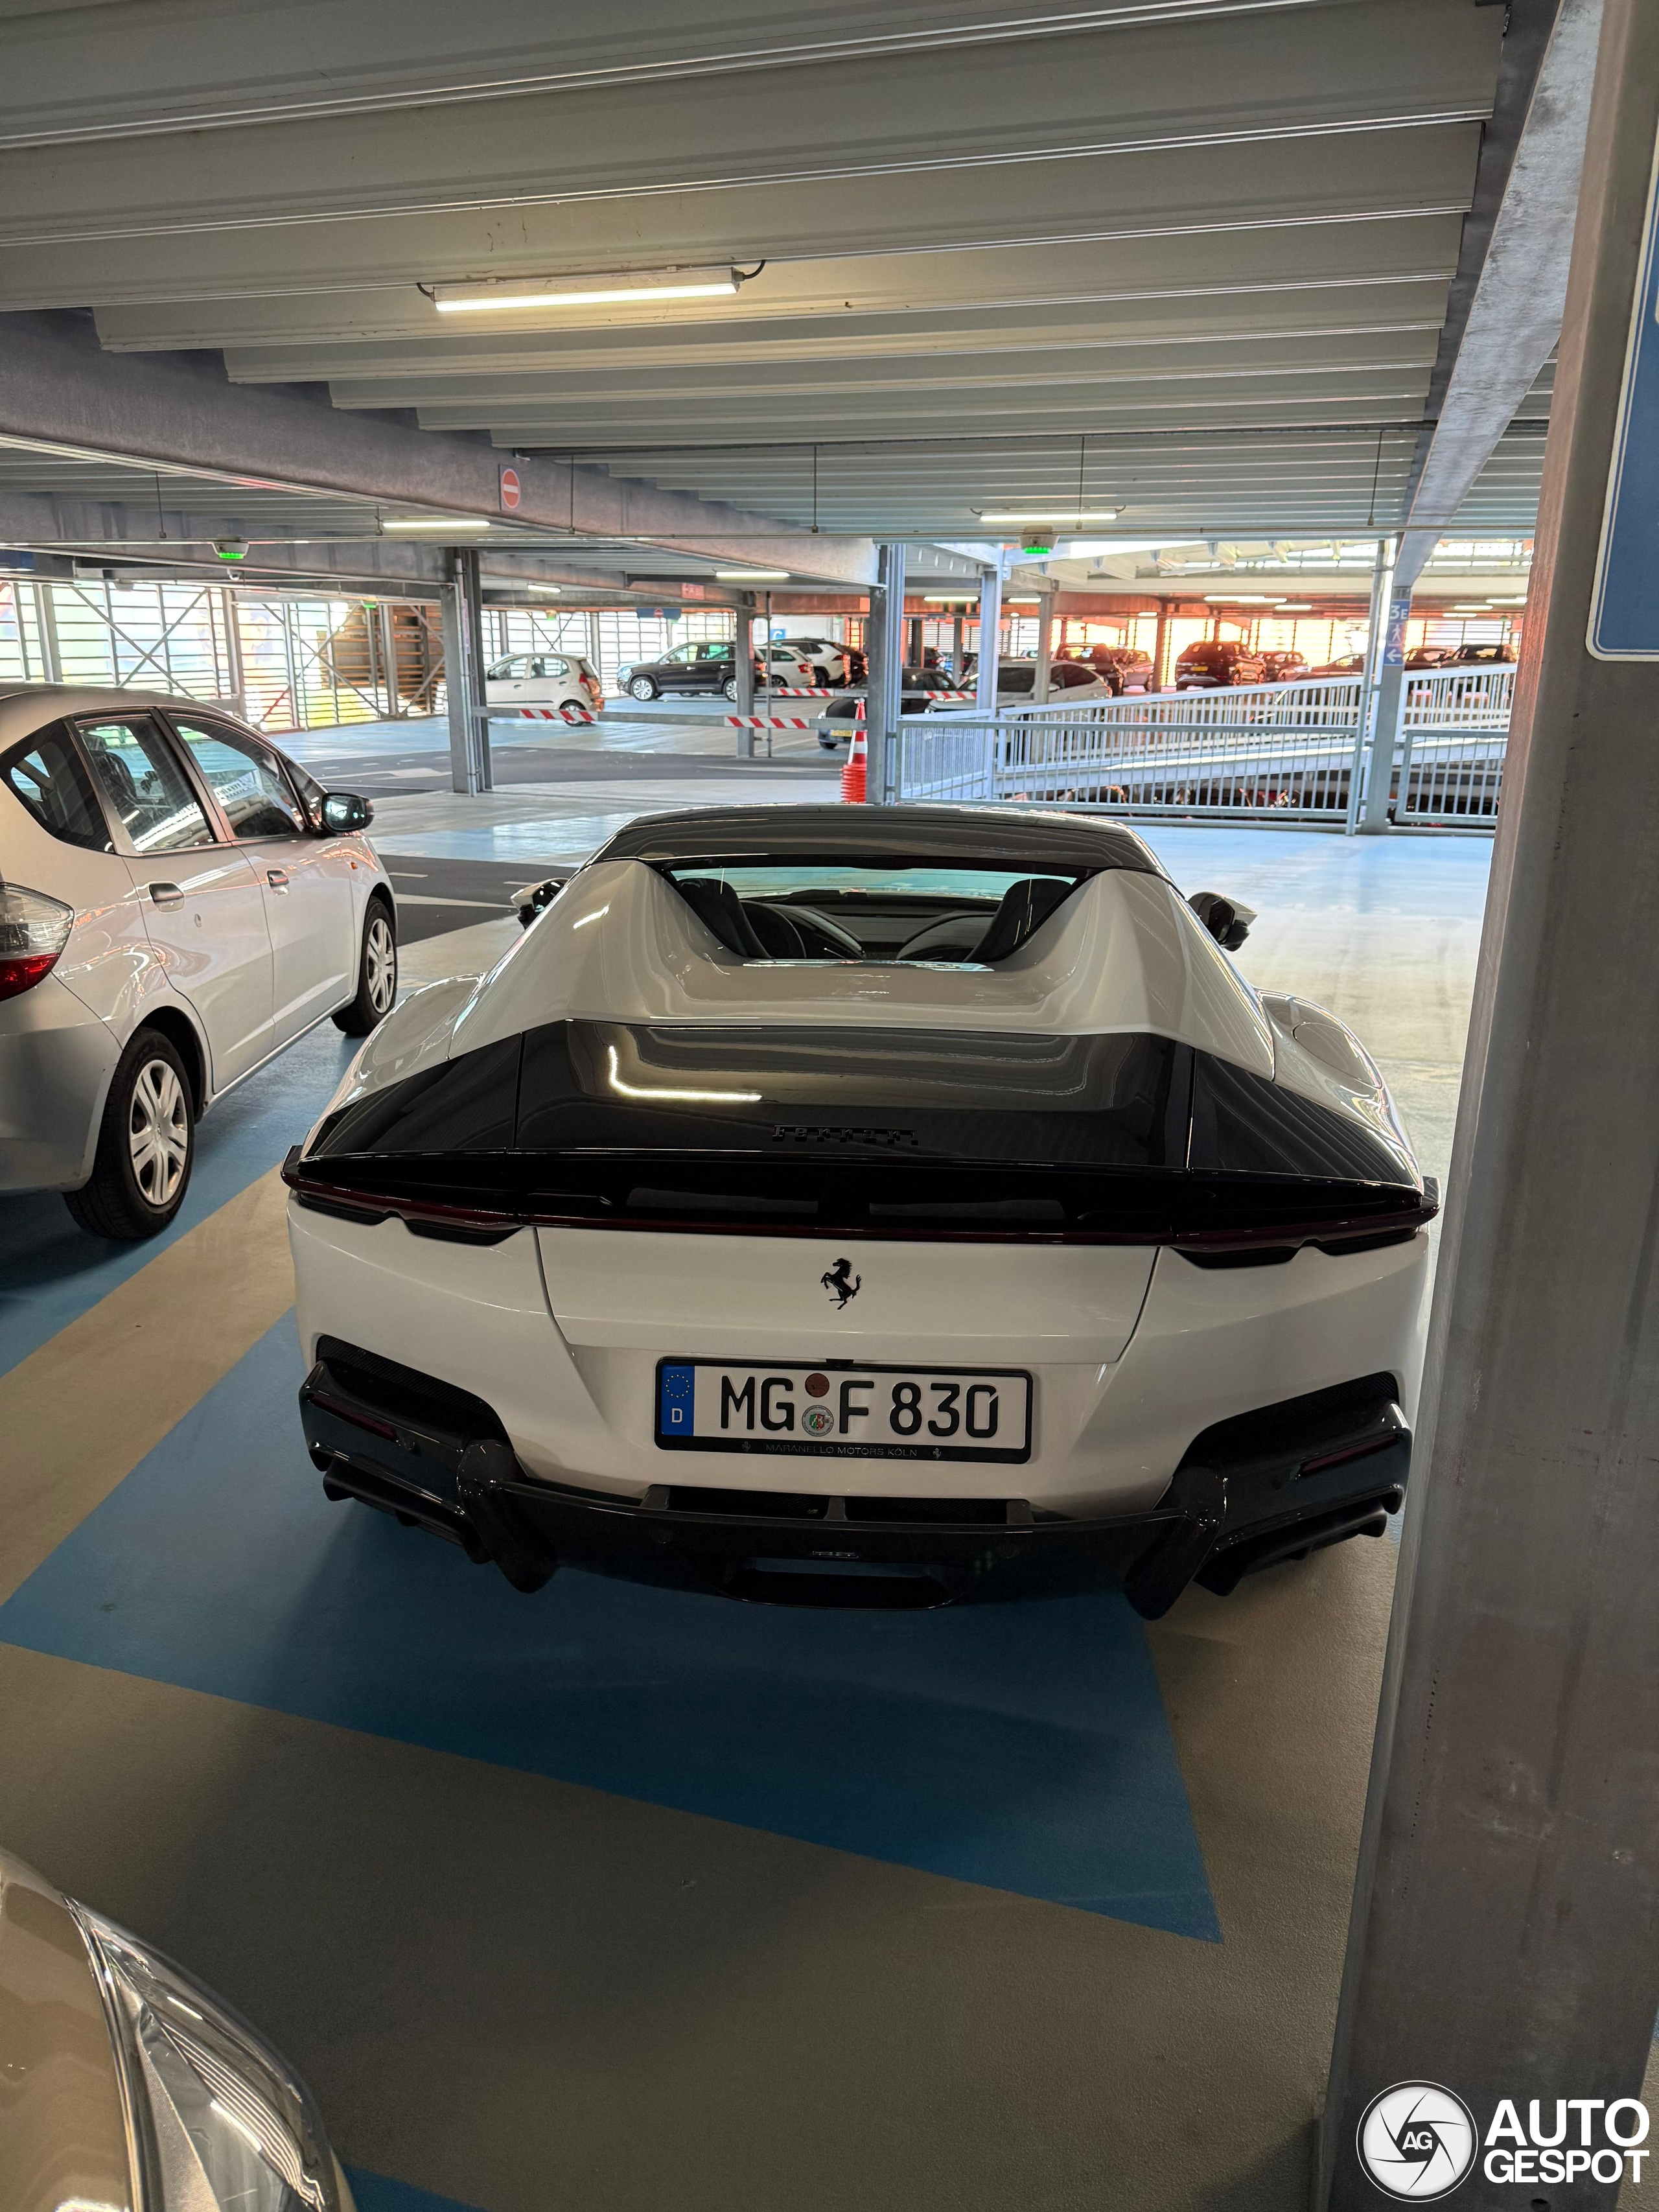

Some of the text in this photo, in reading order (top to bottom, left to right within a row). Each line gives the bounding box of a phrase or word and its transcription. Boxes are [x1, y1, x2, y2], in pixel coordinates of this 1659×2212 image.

[772, 1125, 918, 1144] Ferrari
[671, 1408, 683, 1423] D
[721, 1375, 998, 1439] MG F 830
[765, 1444, 917, 1457] MARANELLO MOTORS KÖLN
